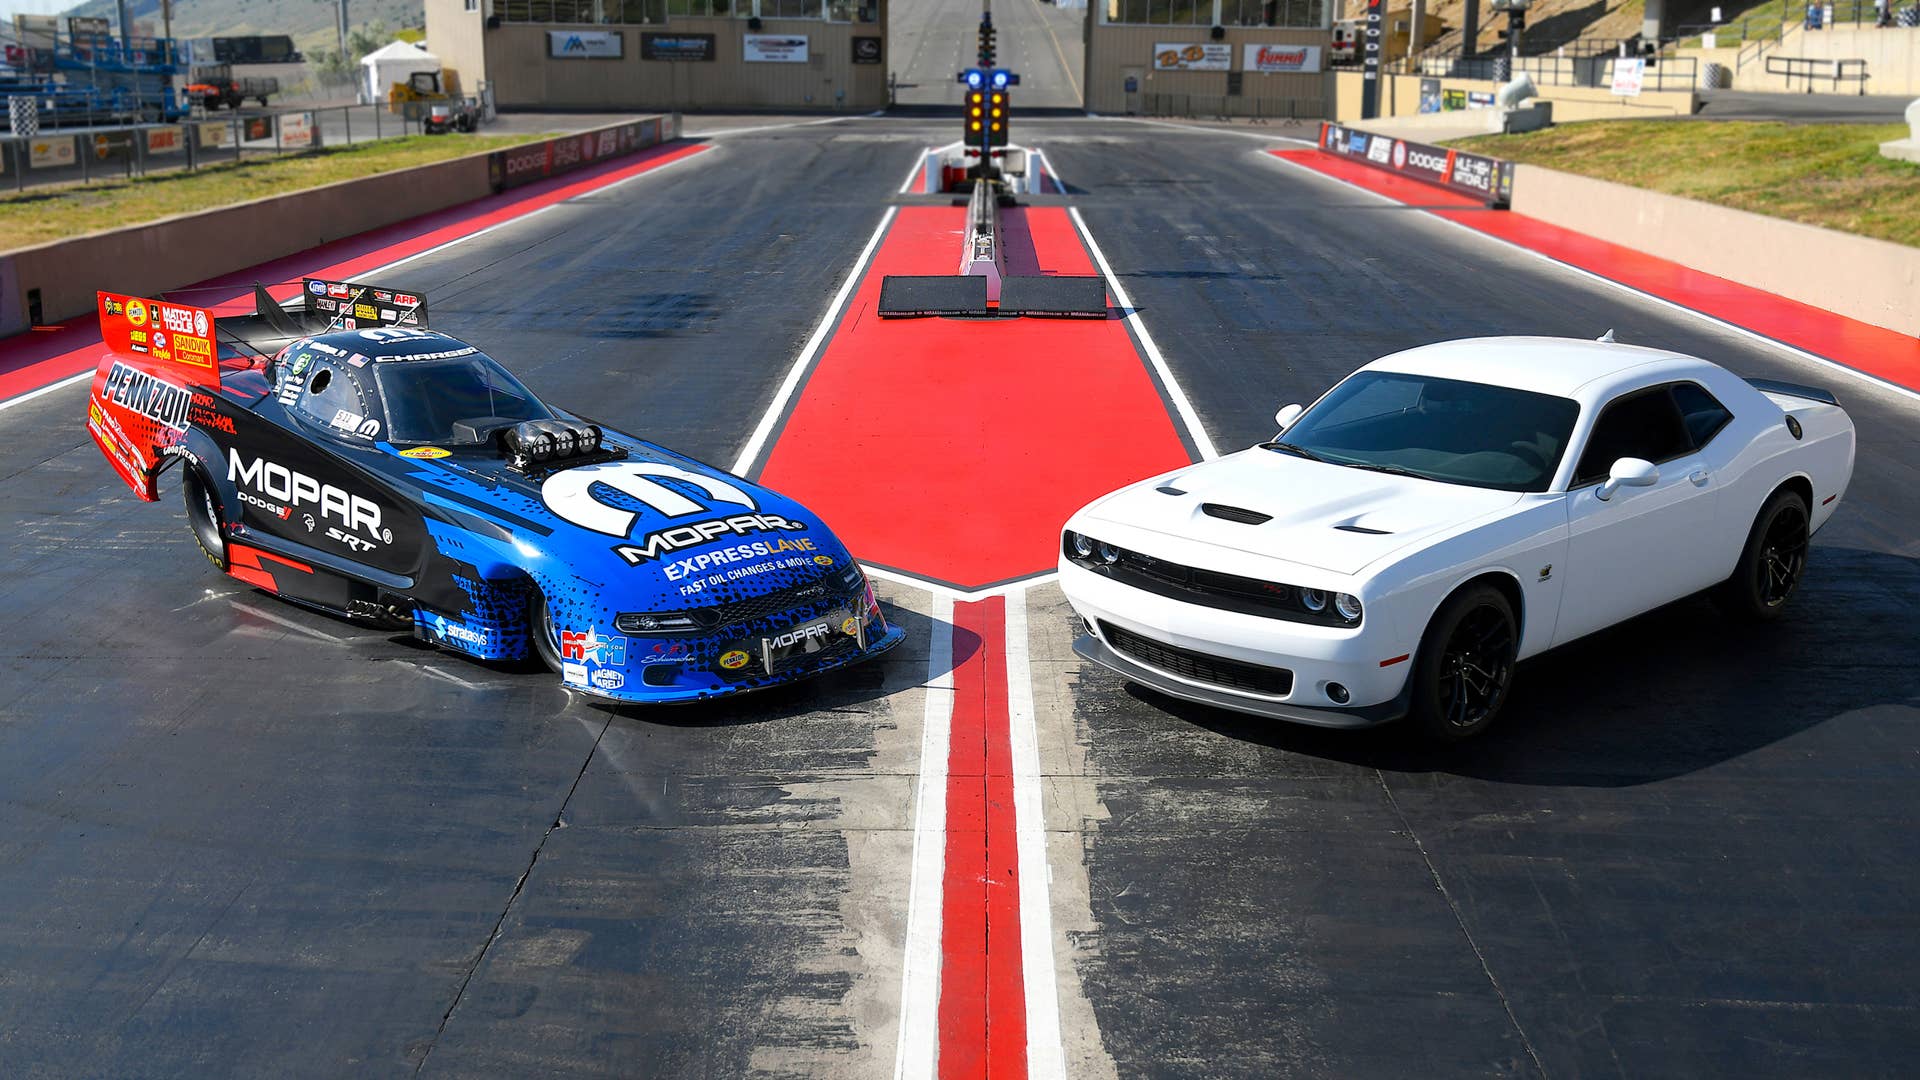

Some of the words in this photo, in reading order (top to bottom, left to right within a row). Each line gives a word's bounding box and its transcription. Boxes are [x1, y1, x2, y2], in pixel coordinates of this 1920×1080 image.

[1408, 151, 1447, 173] DODGE
[395, 295, 417, 305] ARP
[162, 306, 193, 322] MATCO
[166, 319, 195, 334] TOOLS
[174, 335, 210, 354] SANDVIK
[375, 346, 480, 363] CHARGER
[102, 361, 192, 433] PENNZOIL
[227, 447, 384, 541] MOPAR
[237, 491, 286, 517] DODGE
[325, 527, 377, 552] SRT
[617, 513, 795, 568] MOPAR
[679, 580, 708, 597] FAST
[710, 573, 728, 586] OIL
[727, 562, 777, 583] CHANGES
[776, 559, 787, 571] &
[447, 623, 487, 647] stratasys
[641, 653, 697, 664] Schumacher
[723, 654, 746, 666] PENNZOIL
